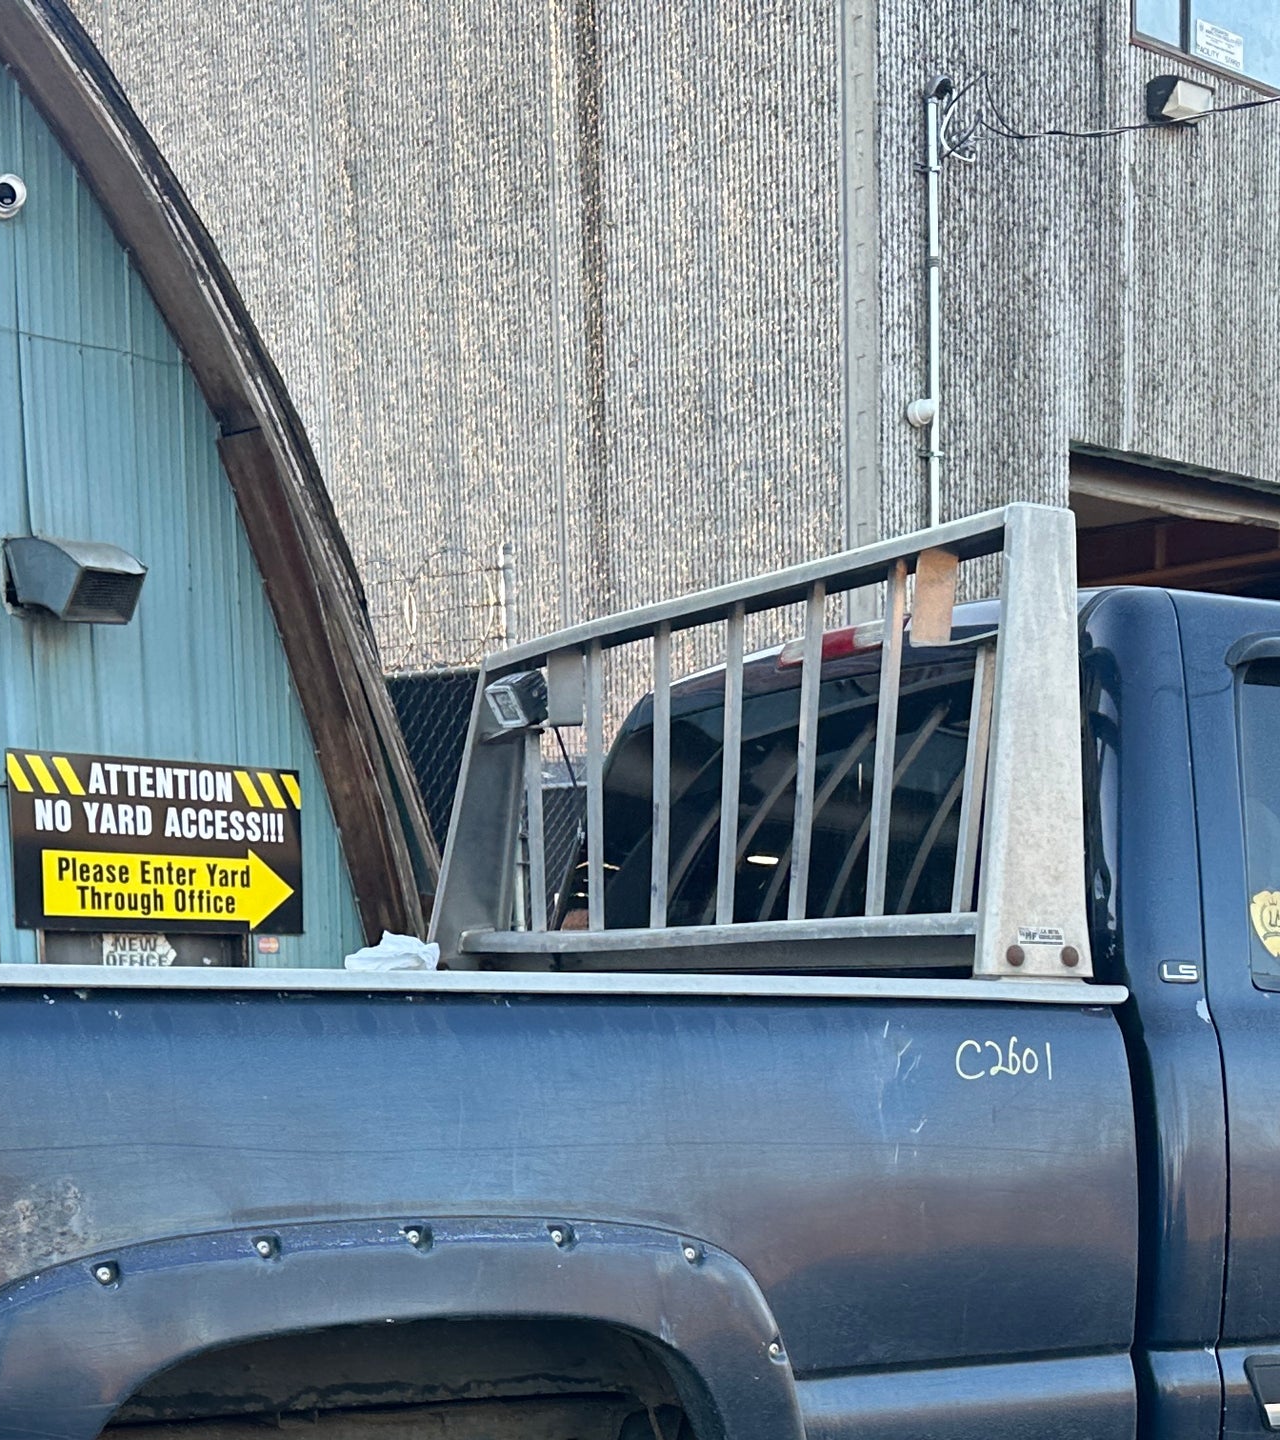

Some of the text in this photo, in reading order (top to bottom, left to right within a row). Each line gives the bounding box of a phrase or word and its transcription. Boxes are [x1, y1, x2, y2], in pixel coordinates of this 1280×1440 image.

[89, 762, 233, 803] ATTENTION
[34, 799, 285, 843] NO YARD ACCESS!!!
[58, 857, 251, 888] Please Enter Yard
[76, 886, 236, 915] Through Office
[114, 934, 159, 951] NEW
[105, 951, 171, 967] OFFICE
[1162, 963, 1199, 982] LS
[955, 1036, 1053, 1081] C2601
